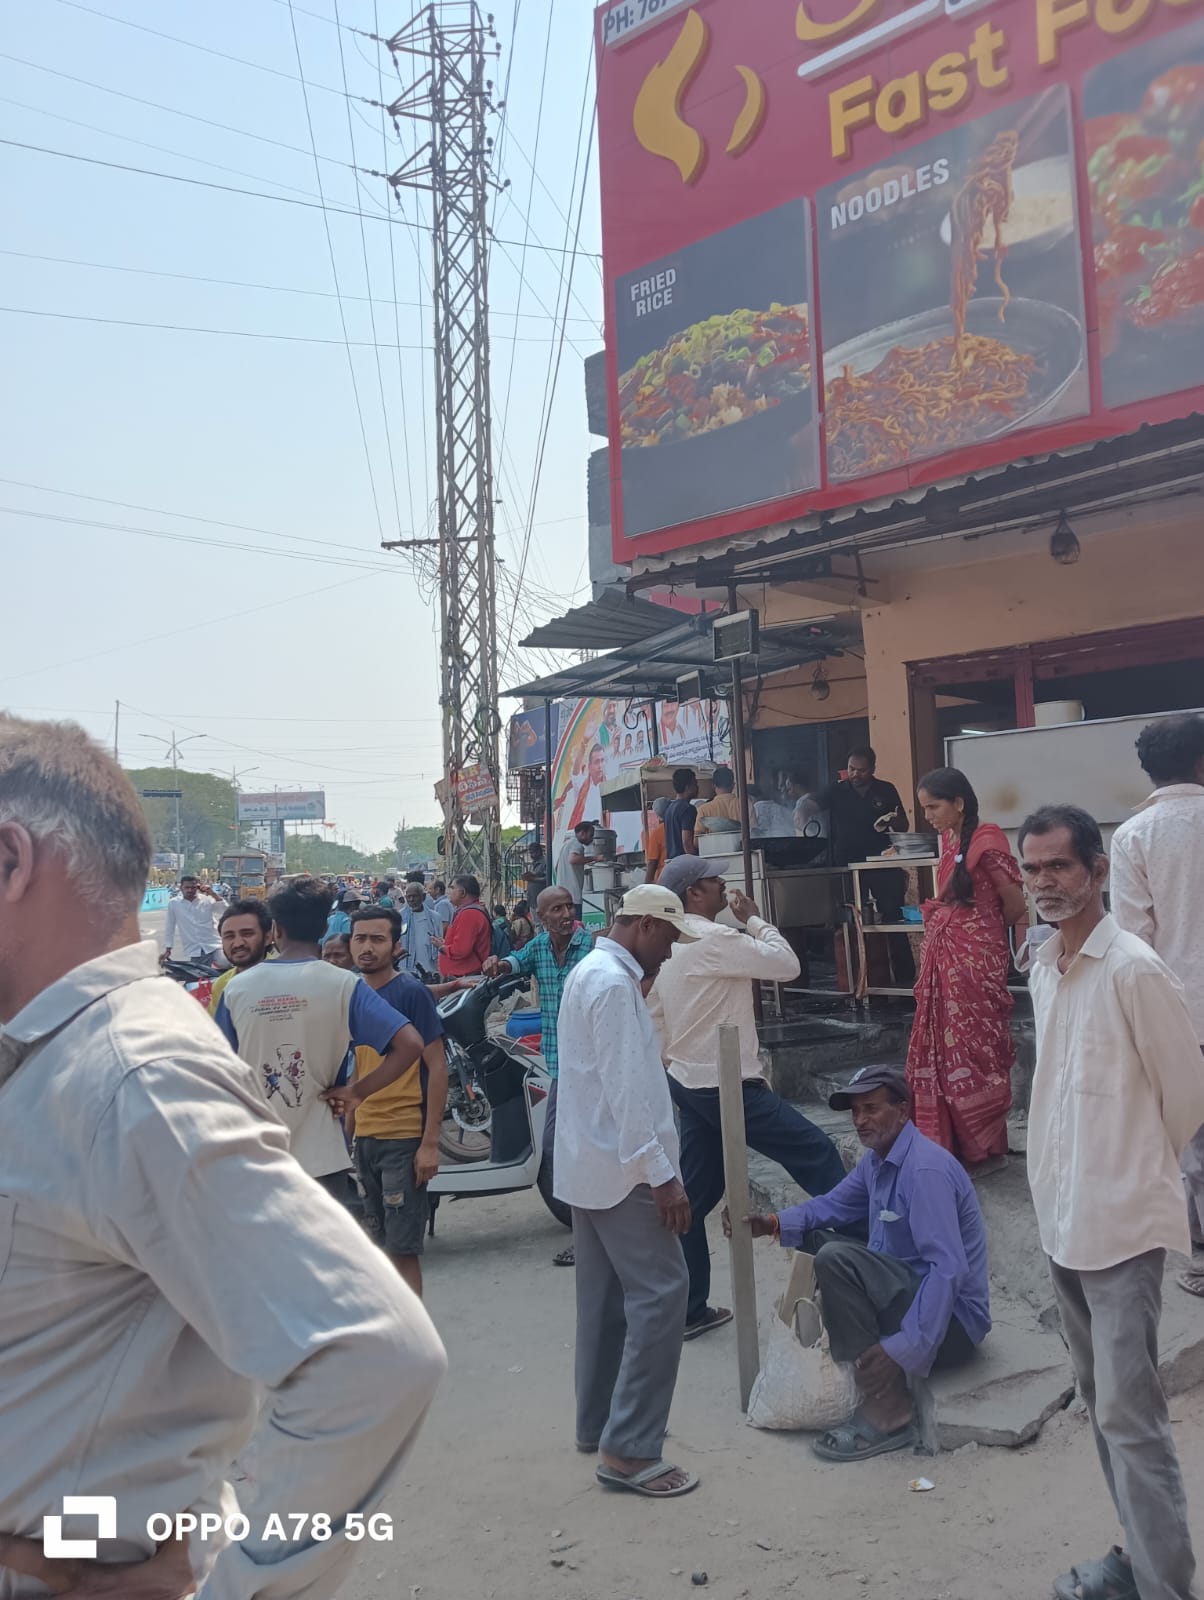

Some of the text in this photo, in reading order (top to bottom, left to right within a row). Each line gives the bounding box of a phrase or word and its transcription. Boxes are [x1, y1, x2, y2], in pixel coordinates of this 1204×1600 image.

[604, 6, 634, 38] PH:
[829, 21, 1009, 158] Fast
[831, 158, 950, 229] NOODLES
[631, 268, 676, 301] FRIED
[636, 288, 673, 317] RICE
